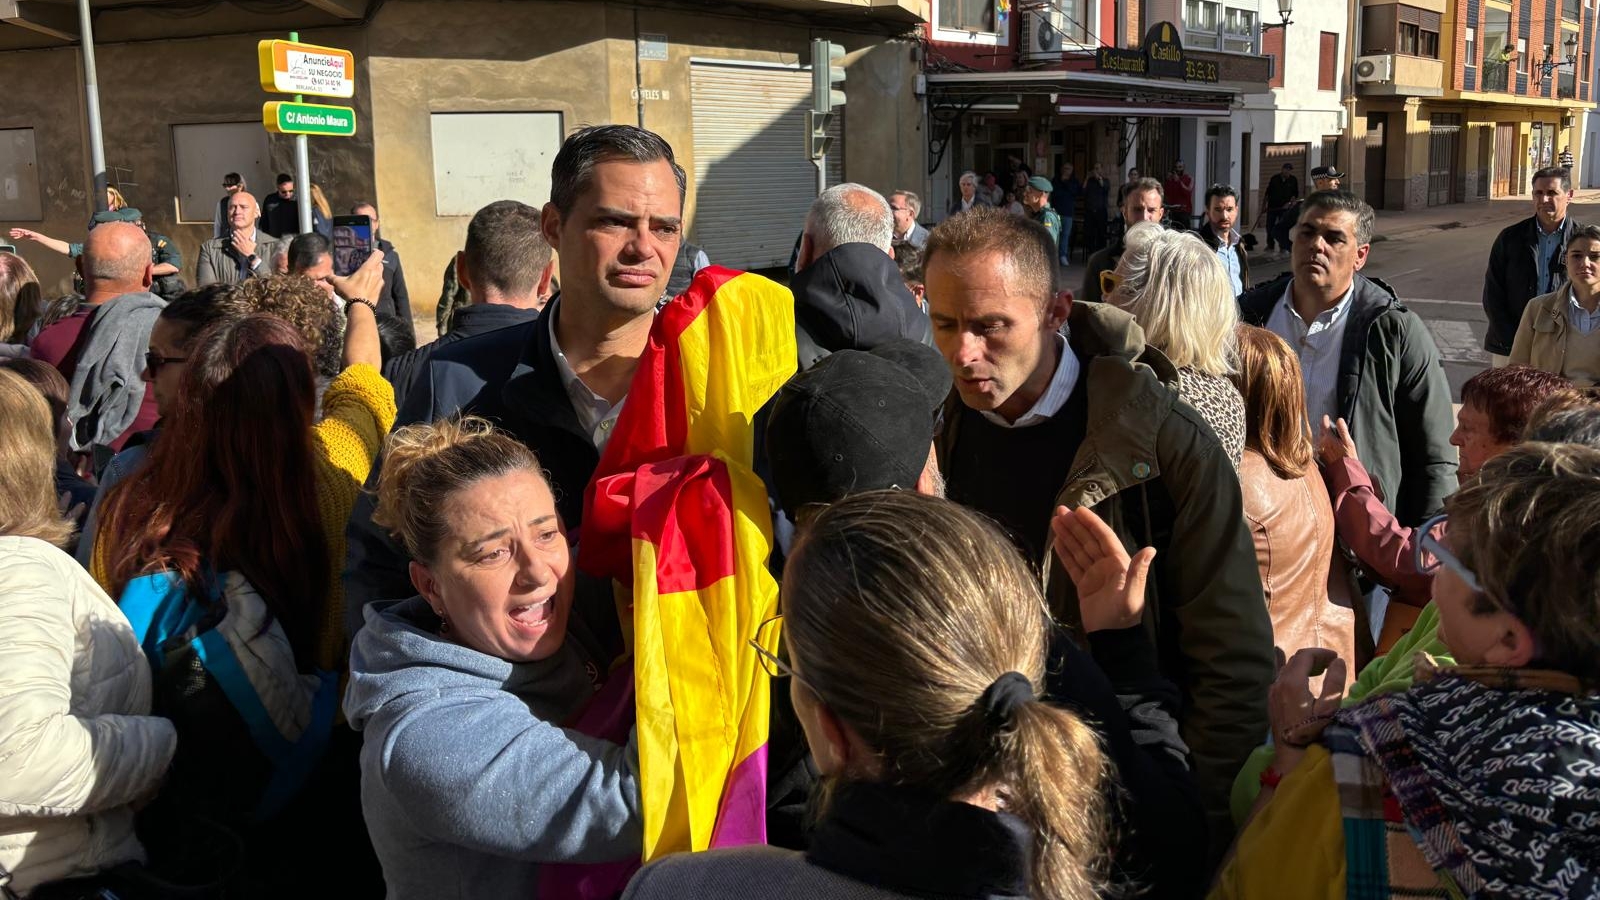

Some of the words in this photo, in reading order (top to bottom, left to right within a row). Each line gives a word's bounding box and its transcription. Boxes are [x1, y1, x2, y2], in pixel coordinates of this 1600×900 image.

[1151, 42, 1181, 62] Castillo
[317, 69, 342, 78] NEGOCIO
[1102, 50, 1145, 72] Restaurante
[1186, 60, 1217, 81] BAR
[286, 111, 295, 124] C/
[296, 112, 326, 126] Antonio
[326, 114, 348, 127] Maura
